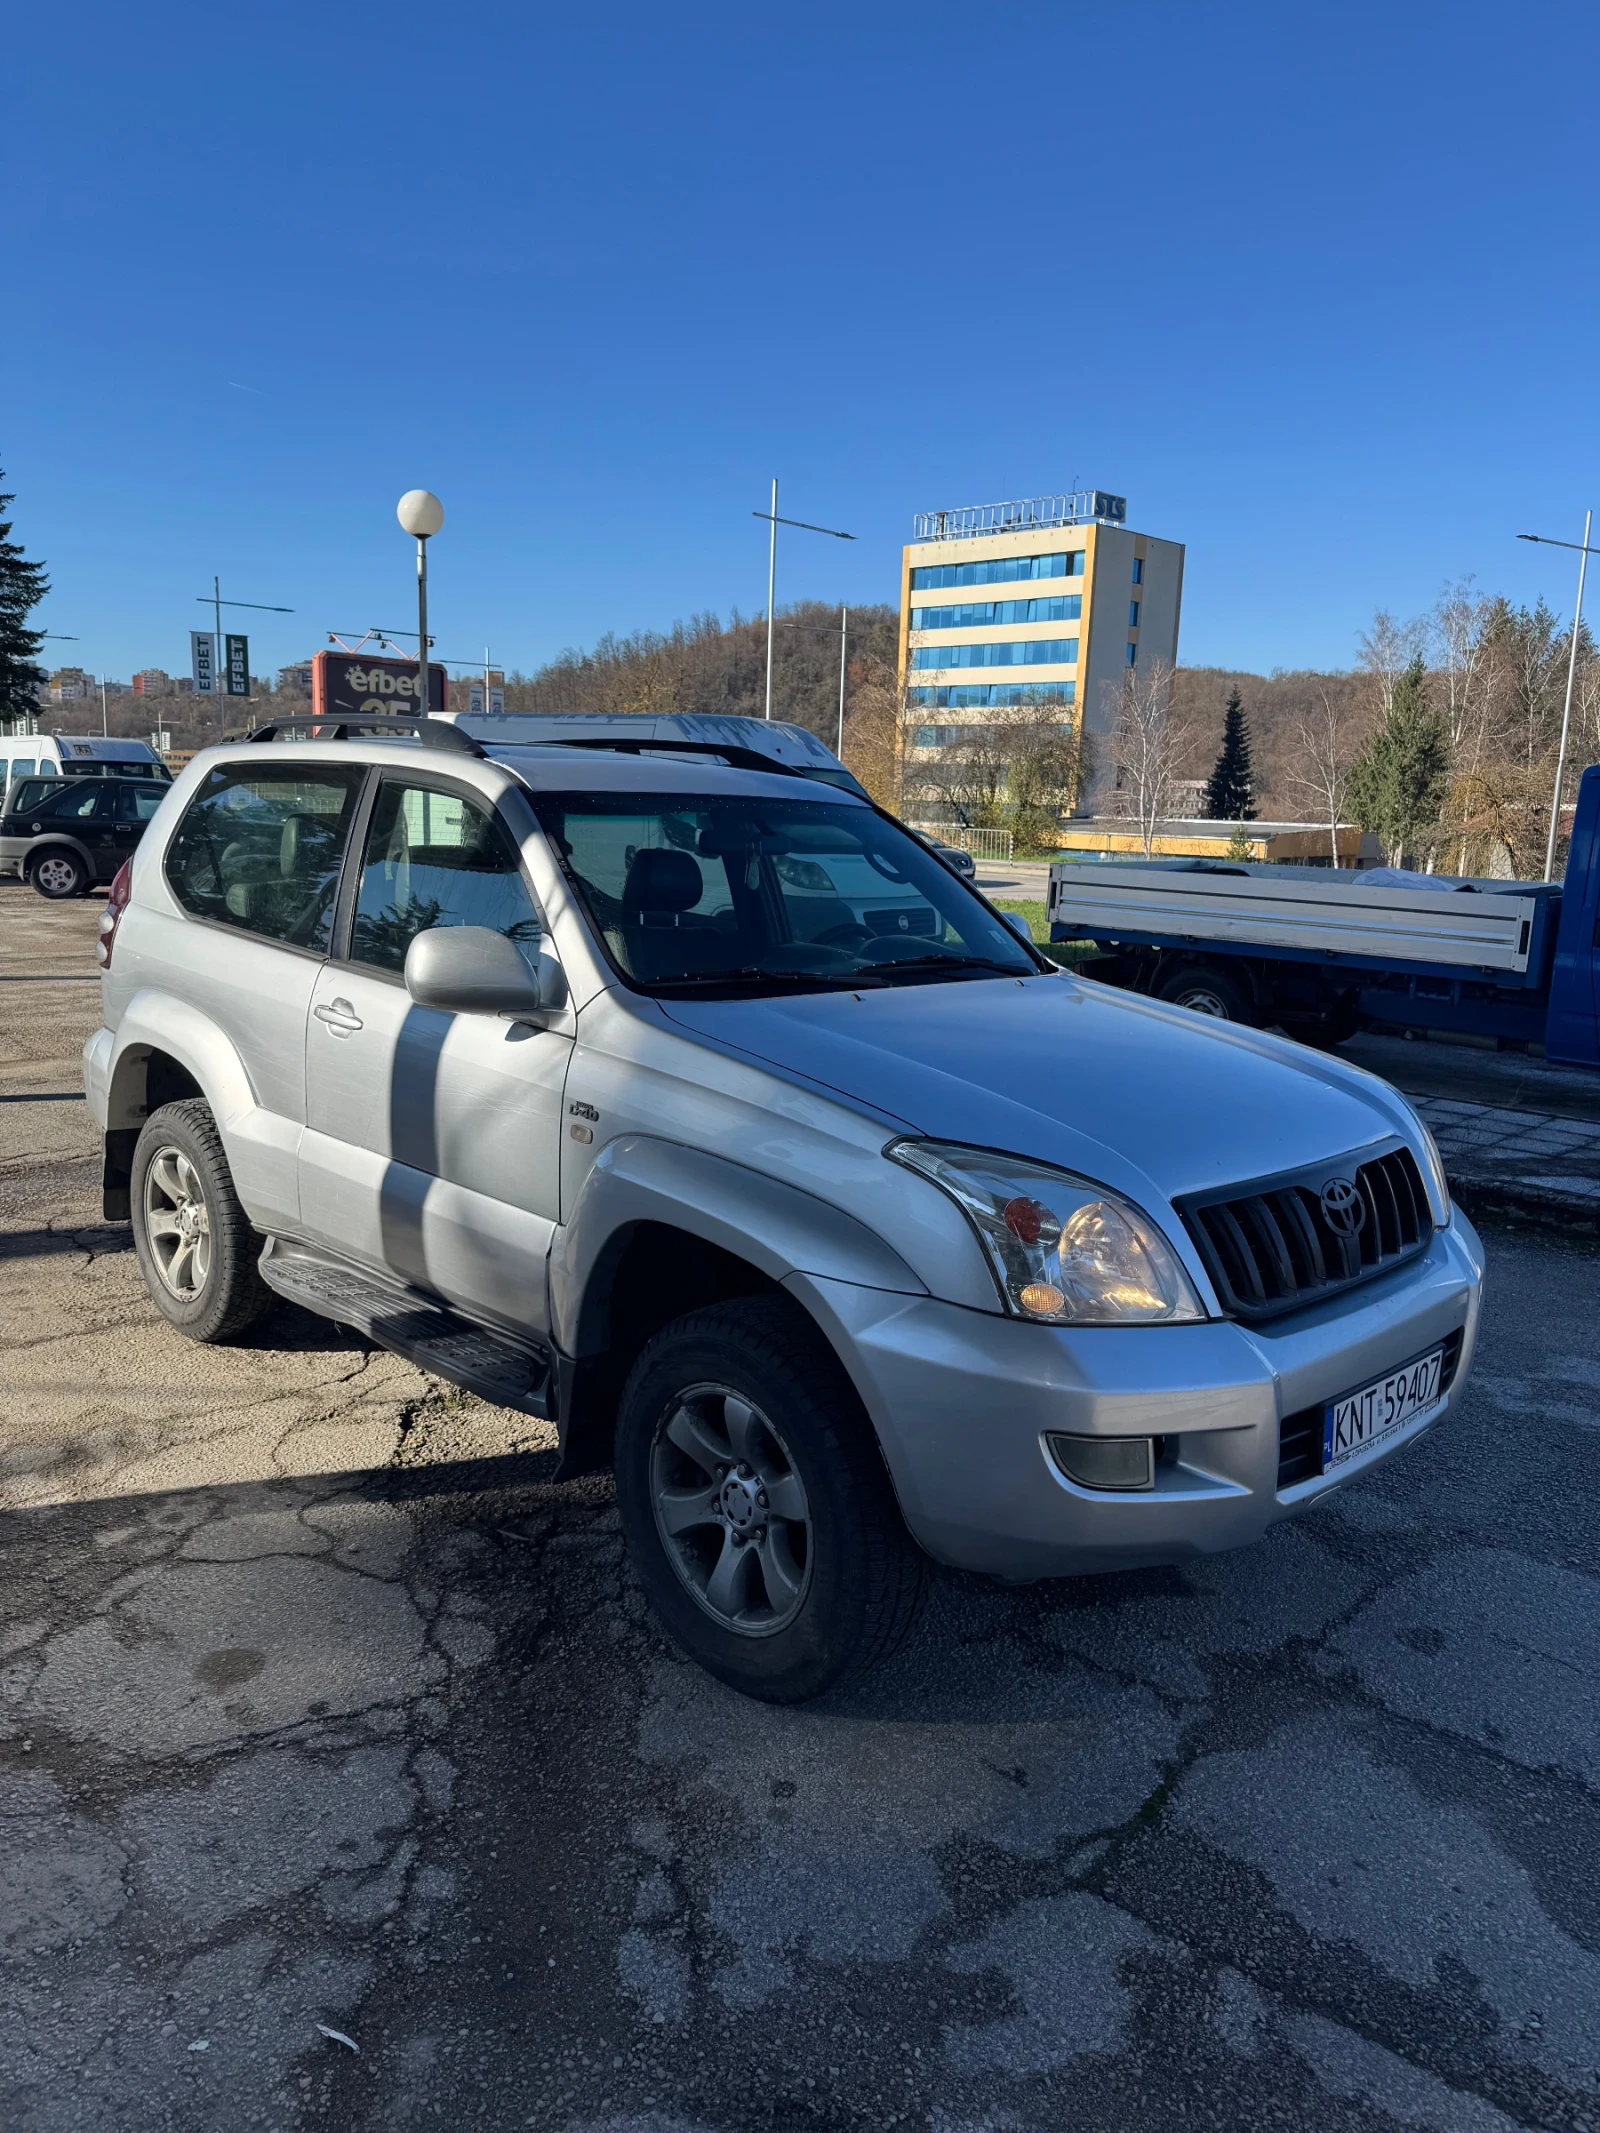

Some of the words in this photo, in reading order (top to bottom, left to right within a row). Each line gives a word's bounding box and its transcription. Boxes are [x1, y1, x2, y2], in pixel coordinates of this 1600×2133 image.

[197, 636, 211, 690] EFBET
[230, 638, 245, 693] EFBET
[349, 669, 422, 698] efbet
[1335, 1389, 1377, 1453] KNT
[1384, 1355, 1440, 1424] 59407
[1324, 1441, 1331, 1452] PL
